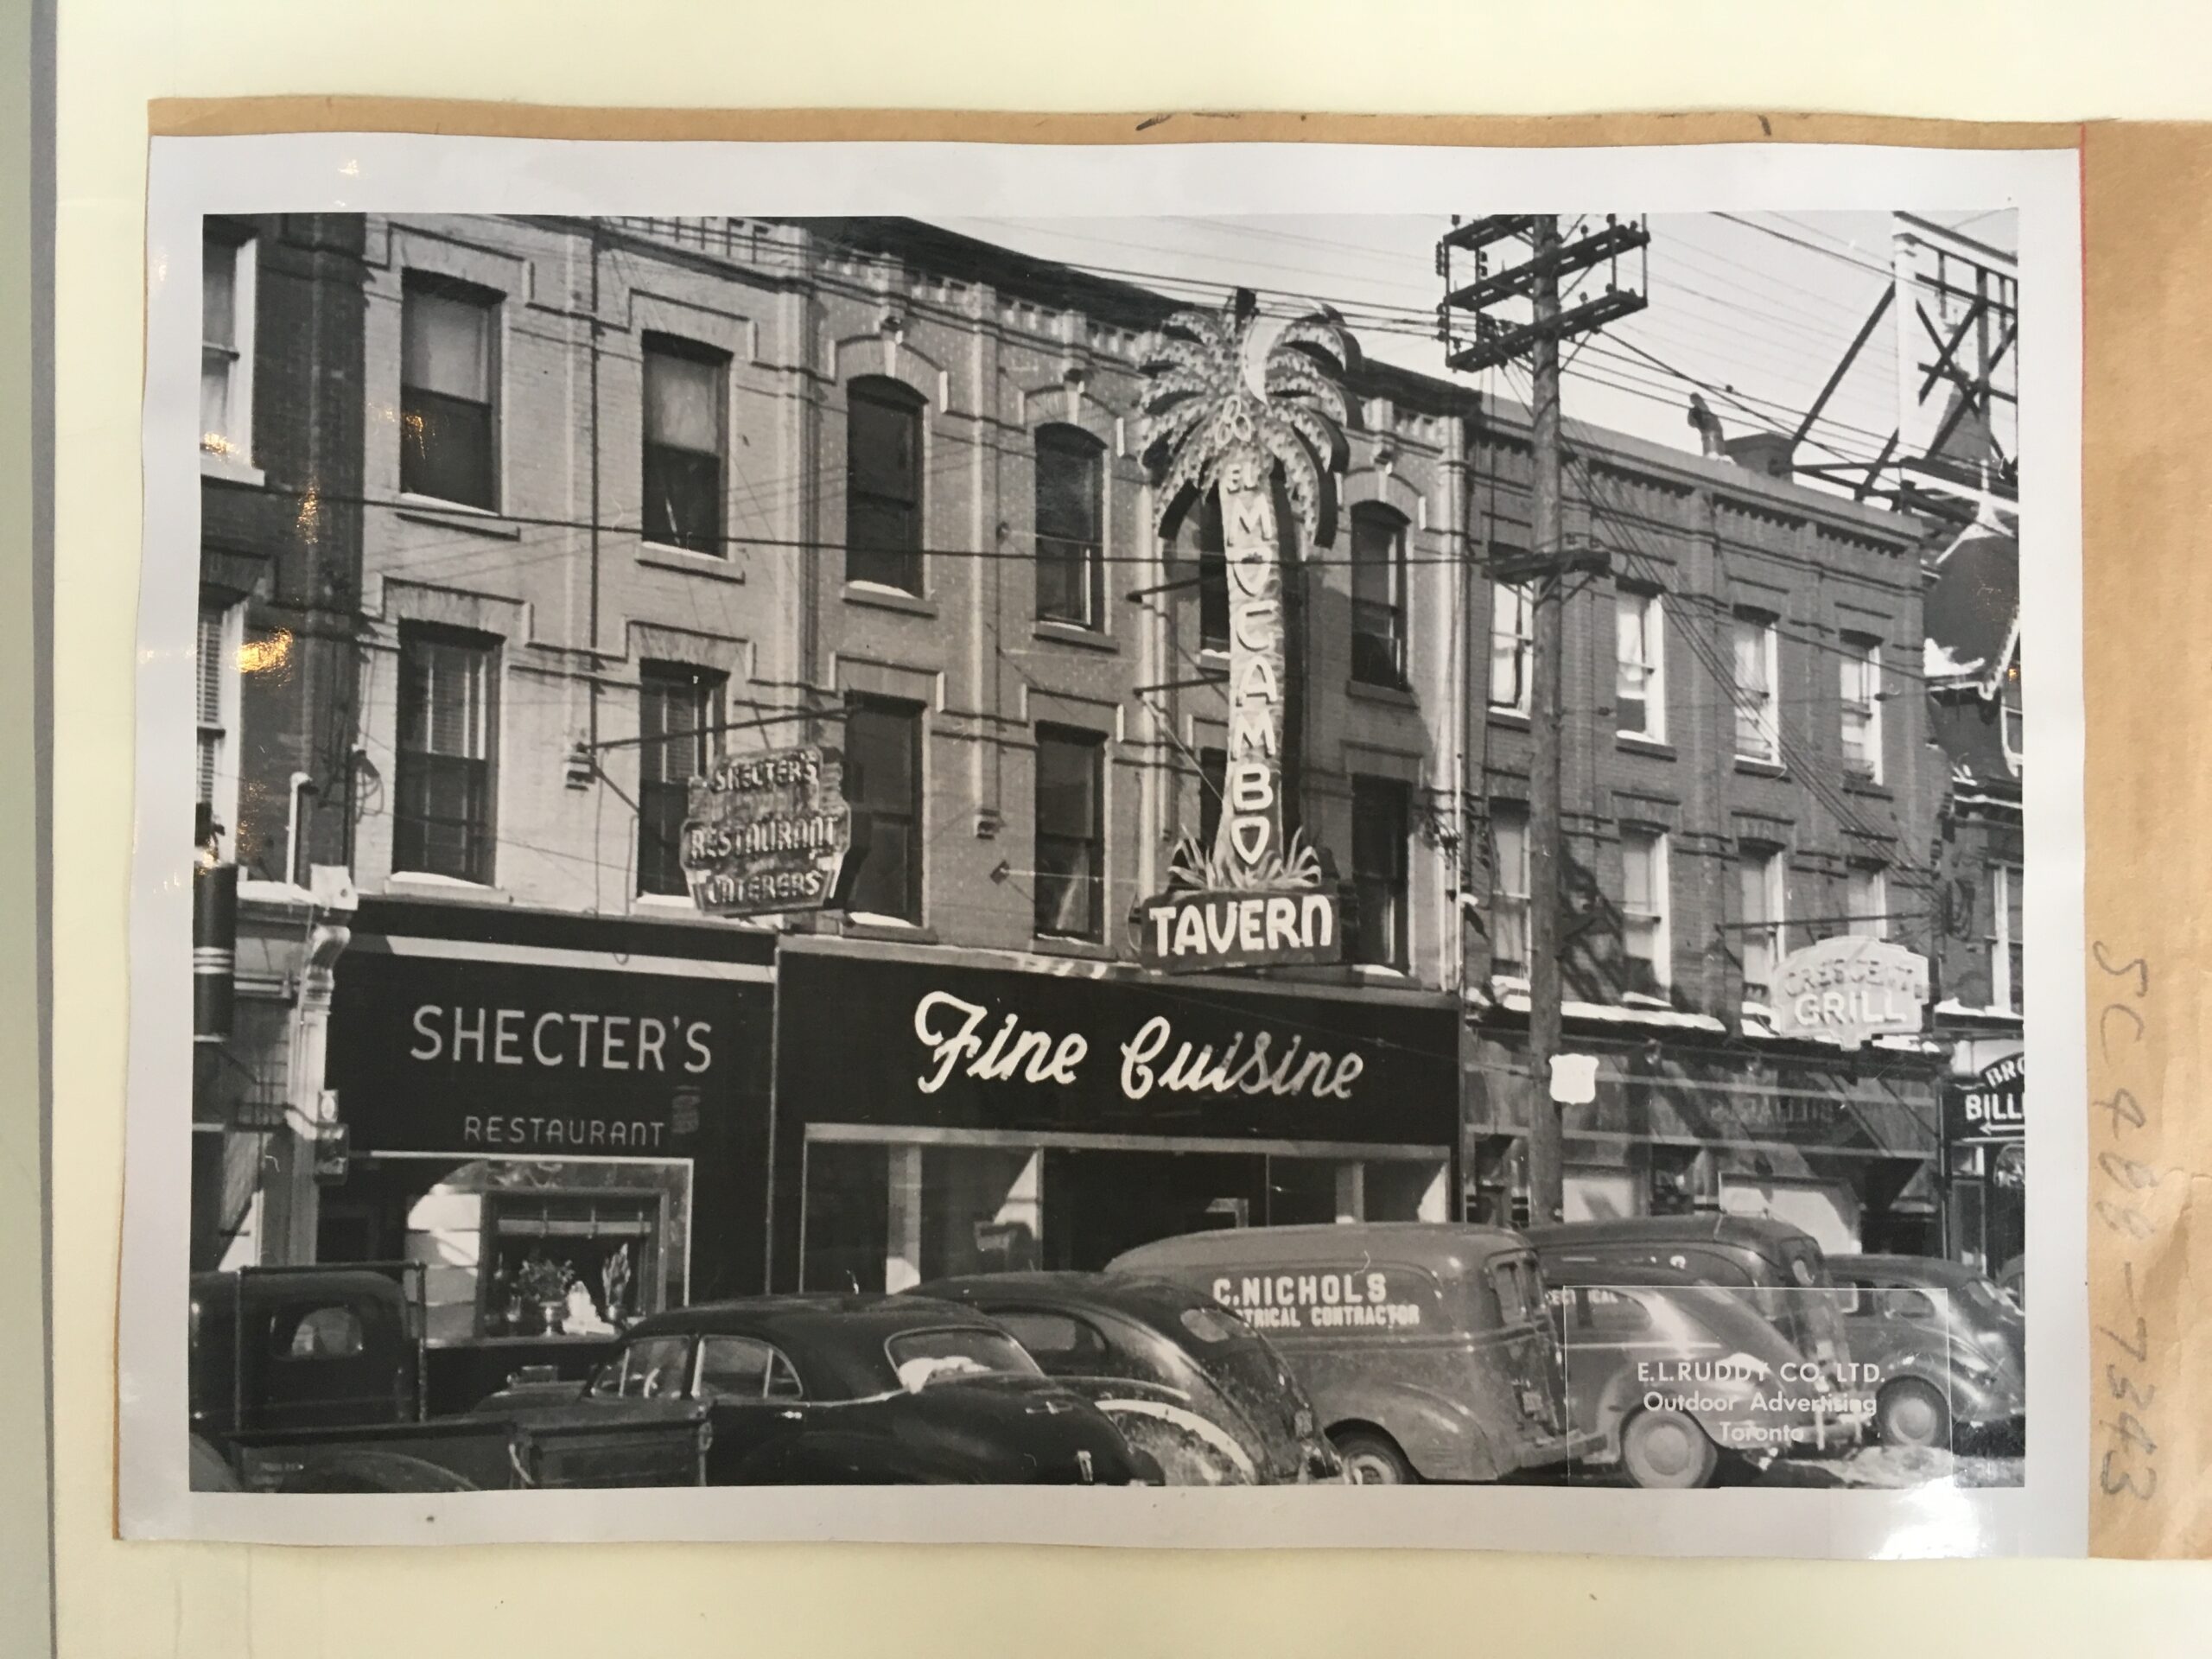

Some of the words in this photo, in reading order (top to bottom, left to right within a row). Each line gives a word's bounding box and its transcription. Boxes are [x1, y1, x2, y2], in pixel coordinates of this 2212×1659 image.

[1227, 493, 1278, 865] MOCAMBO
[1148, 893, 1333, 957] TAVERN
[410, 1005, 713, 1073] SHECTER'S
[1795, 989, 1908, 1026] GRILL
[913, 990, 1088, 1094] Fine
[1121, 1015, 1364, 1100] Cuisine
[464, 1115, 665, 1147] RESTAURANT
[1310, 1303, 1421, 1328] CONTRACTOR
